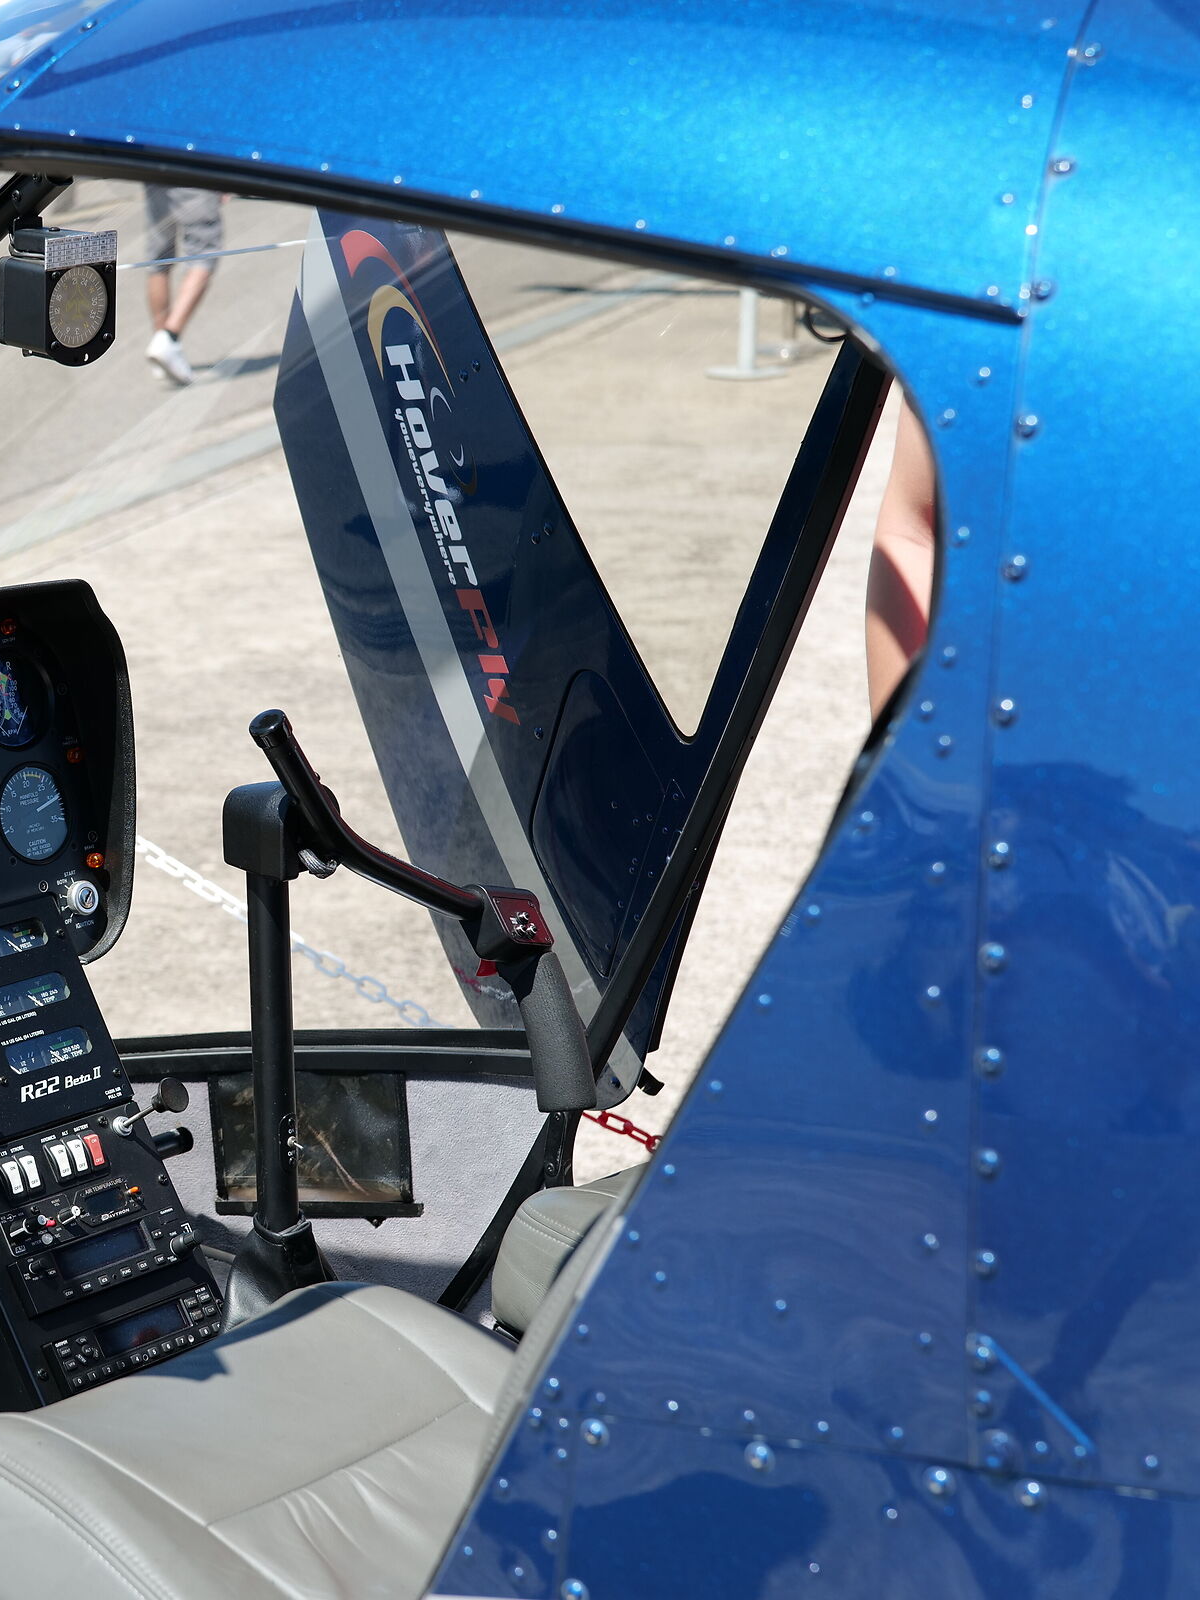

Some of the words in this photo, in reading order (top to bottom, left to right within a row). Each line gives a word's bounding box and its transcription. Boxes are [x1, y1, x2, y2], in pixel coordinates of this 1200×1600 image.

[5, 661, 12, 671] R
[22, 779, 30, 789] 20
[36, 783, 46, 792] 25
[10, 789, 18, 798] 15
[19, 791, 39, 801] MANIFOLD
[19, 797, 40, 807] PRESSURE
[9, 825, 15, 833] 5
[28, 838, 47, 848] CAUTION
[63, 869, 76, 878] START
[56, 878, 68, 887] BOTH
[64, 917, 73, 925] OFF
[75, 919, 95, 930] IGNITION
[20, 1076, 61, 1104] R22
[64, 1073, 93, 1089] Beta
[73, 1123, 89, 1133] BATTERY
[40, 1134, 57, 1143] AVIONICS
[10, 1144, 25, 1153] STROBE
[84, 1186, 94, 1195] AIR
[92, 1177, 123, 1192] TEMPERATURE
